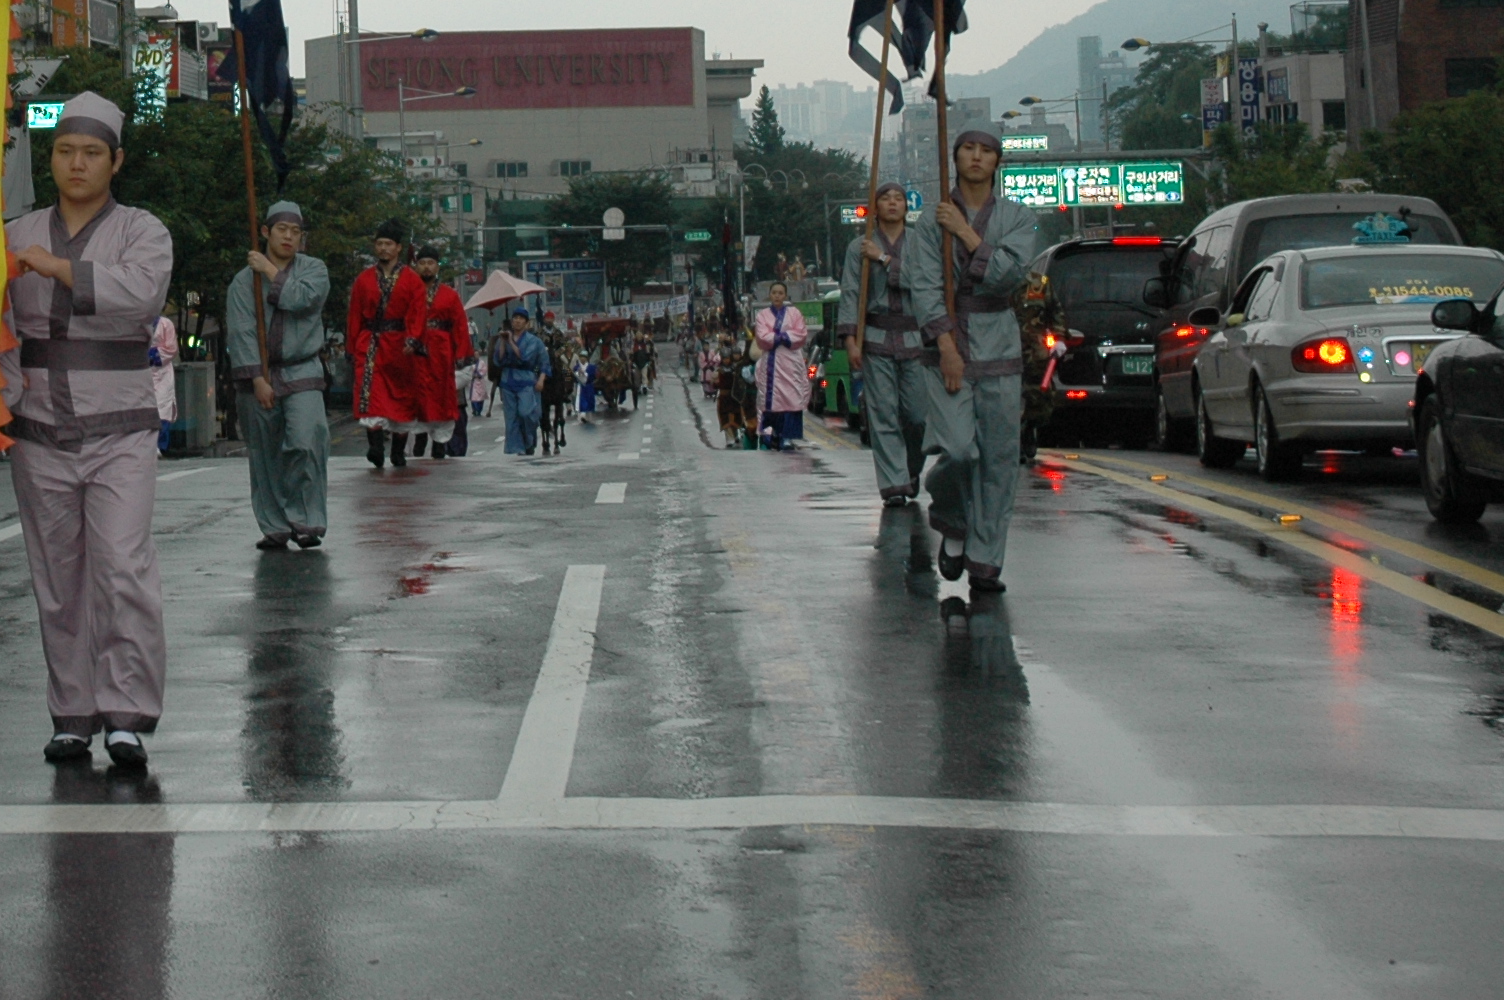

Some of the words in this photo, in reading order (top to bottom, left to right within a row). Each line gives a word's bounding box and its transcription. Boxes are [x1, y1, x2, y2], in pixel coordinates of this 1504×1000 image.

[134, 49, 163, 66] DVD
[367, 56, 477, 89] SEJONG
[493, 52, 675, 87] UNIVERSITY
[1125, 171, 1179, 184] 구의사거리
[1392, 285, 1474, 298] 1544-0085
